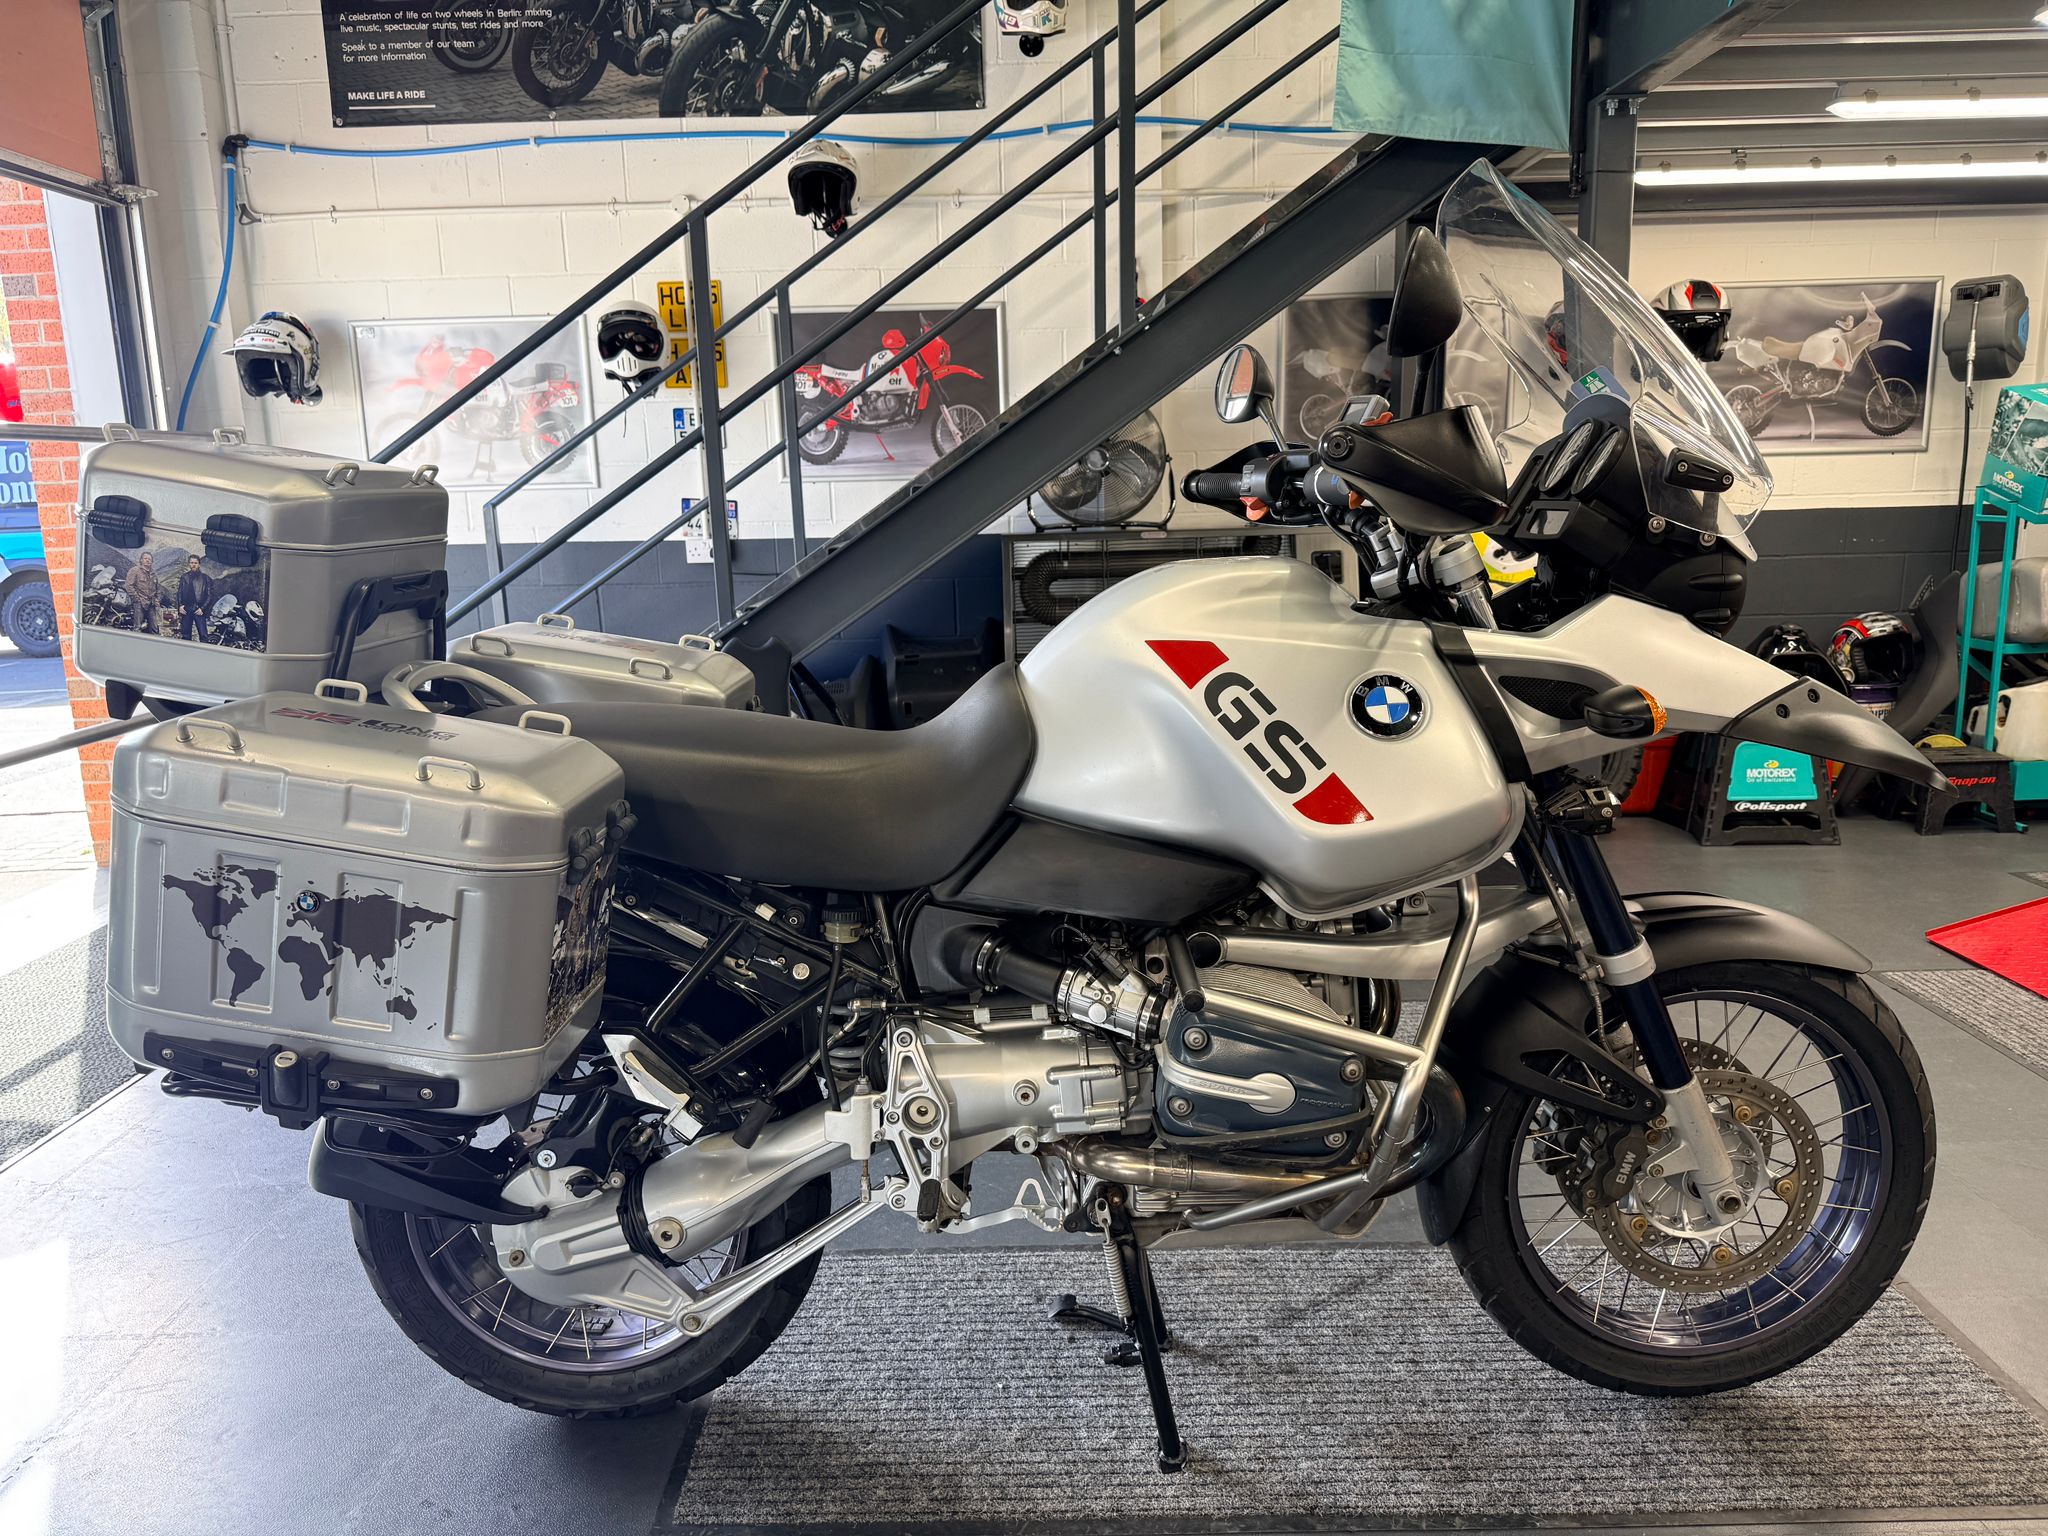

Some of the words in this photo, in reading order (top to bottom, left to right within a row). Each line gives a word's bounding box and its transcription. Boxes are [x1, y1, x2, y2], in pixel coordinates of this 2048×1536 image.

[340, 13, 346, 21] A
[348, 12, 391, 21] celebration
[394, 11, 403, 20] of
[406, 11, 418, 19] life
[435, 11, 451, 19] two
[454, 9, 483, 18] wheels
[486, 9, 494, 18] in
[497, 9, 522, 18] Berlin:
[525, 8, 552, 18] mixing
[340, 24, 353, 32] live
[356, 23, 382, 32] music,
[384, 22, 429, 32] spectacular
[432, 21, 459, 30] stunts,
[461, 21, 477, 29] test
[480, 20, 501, 29] rides
[503, 19, 519, 28] and
[341, 42, 366, 52] Speak
[368, 42, 377, 50] to
[388, 41, 422, 49] member
[425, 40, 434, 48] of
[454, 40, 475, 48] team
[343, 53, 355, 62] for
[381, 51, 427, 60] information
[348, 92, 375, 100] MAKE
[376, 91, 395, 100] LIFE
[396, 91, 404, 99] A
[405, 90, 426, 99] RIDE
[1993, 472, 2024, 494] MOTOREX
[1204, 672, 1327, 794] GS
[1746, 767, 1798, 778] MOTOREX
[1735, 801, 1808, 812] Polisport
[1615, 1151, 1637, 1185] BMW
